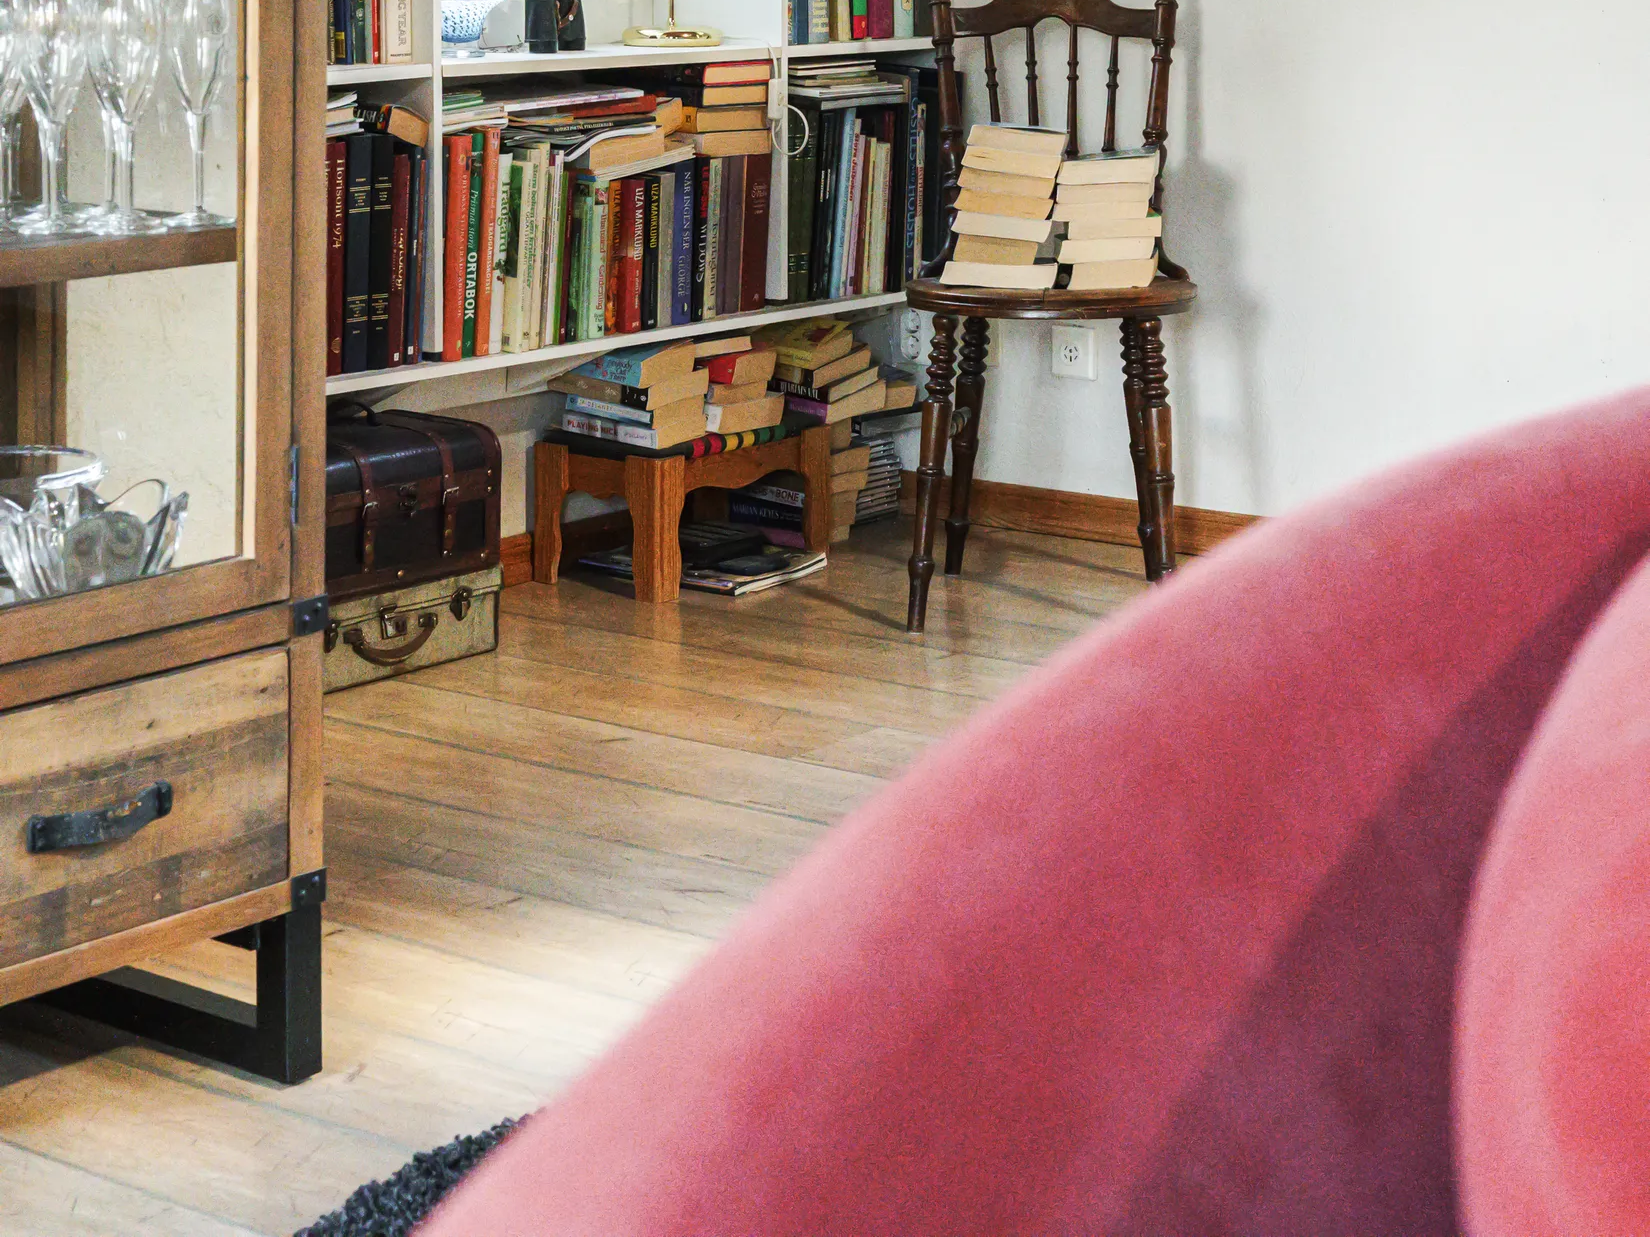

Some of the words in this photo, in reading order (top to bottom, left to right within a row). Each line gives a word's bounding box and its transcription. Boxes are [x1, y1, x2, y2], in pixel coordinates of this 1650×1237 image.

[396, 12, 407, 47] YEAR
[909, 97, 918, 161] CASTLES
[335, 159, 346, 220] Horisont
[651, 183, 660, 200] LIZA
[683, 171, 692, 194] NÄR
[849, 158, 859, 202] Julboken
[468, 188, 480, 226] Prismas
[530, 190, 538, 218] boken
[612, 189, 622, 208] LIZA
[634, 187, 644, 208] LIZA
[682, 195, 691, 229] INGEN
[649, 202, 659, 248] MARKLUND
[906, 184, 917, 249] HOUSES
[332, 222, 345, 250] 1974
[467, 226, 477, 249] stora
[632, 209, 643, 261] MARKLUND
[682, 231, 691, 250] SER
[595, 264, 605, 310] Gardening
[676, 255, 687, 298] GEORGE
[566, 418, 599, 433] PLAYING
[600, 425, 618, 437] NICE
[775, 488, 800, 502] BONE
[759, 507, 780, 520] KEYES
